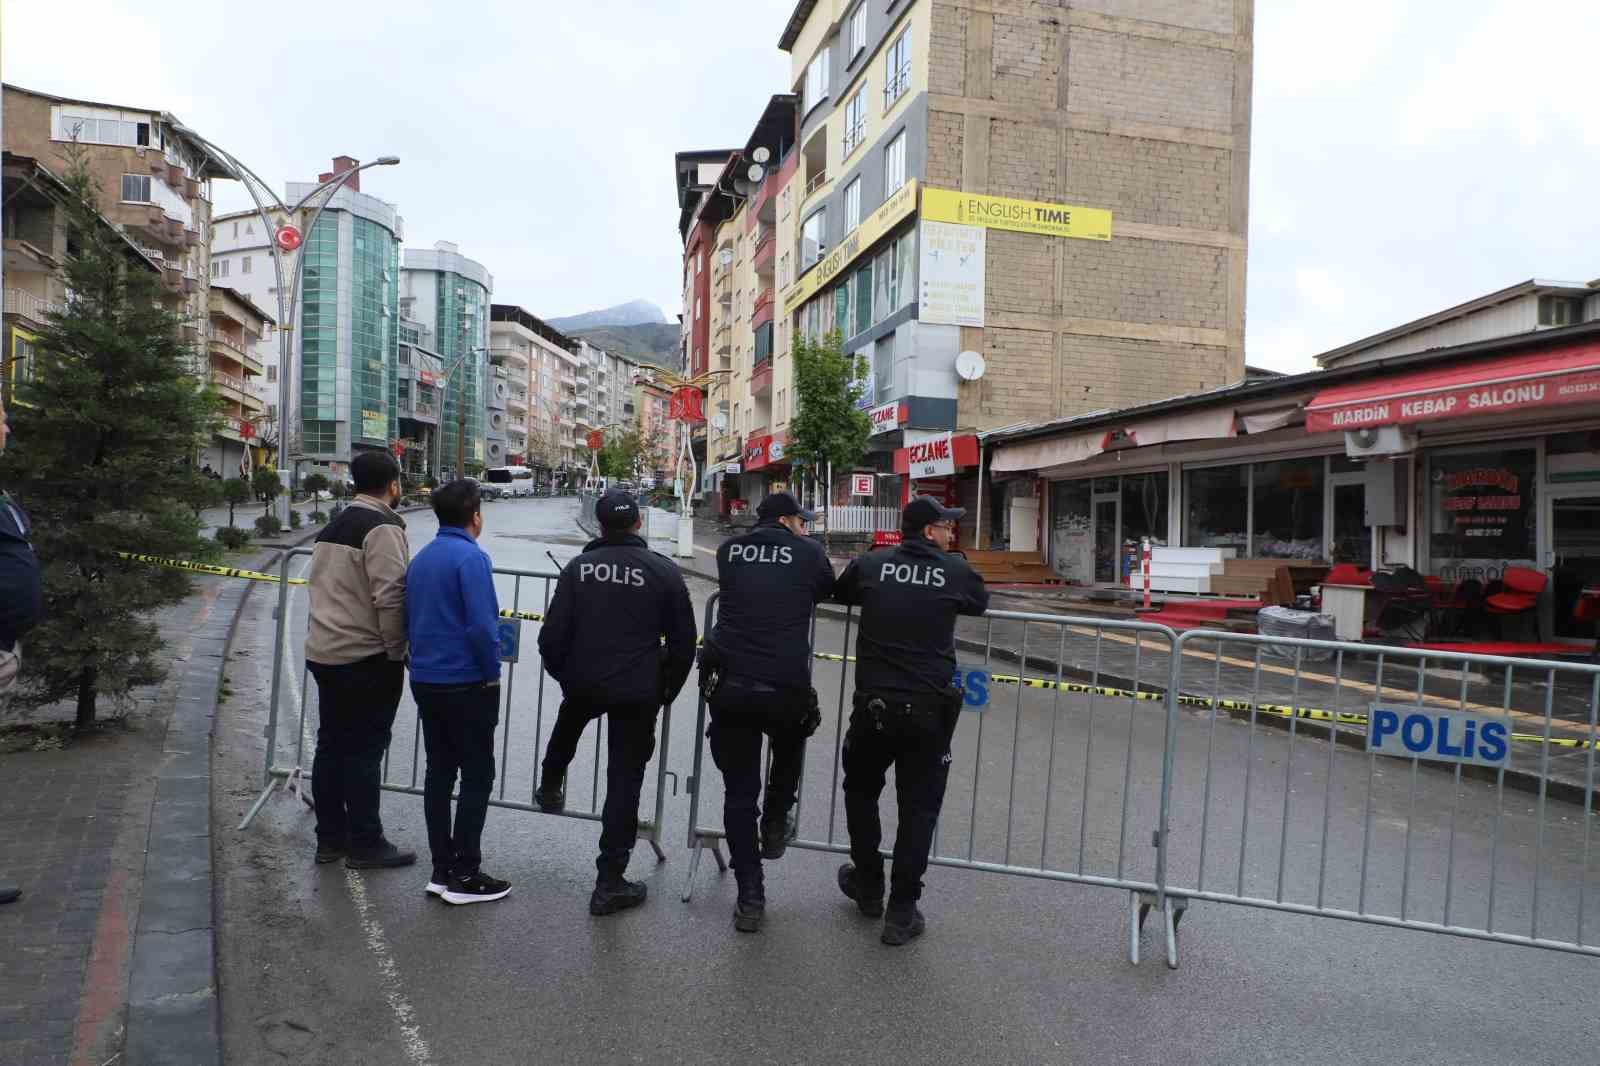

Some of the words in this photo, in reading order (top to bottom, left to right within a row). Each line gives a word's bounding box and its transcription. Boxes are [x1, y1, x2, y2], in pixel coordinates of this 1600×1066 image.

[968, 200, 1031, 220] ENGLISH
[1034, 208, 1071, 225] TIME
[1402, 397, 1457, 417] KEBAP
[1468, 384, 1545, 409] SALONU
[909, 440, 949, 463] ECZANE
[859, 480, 870, 492] E
